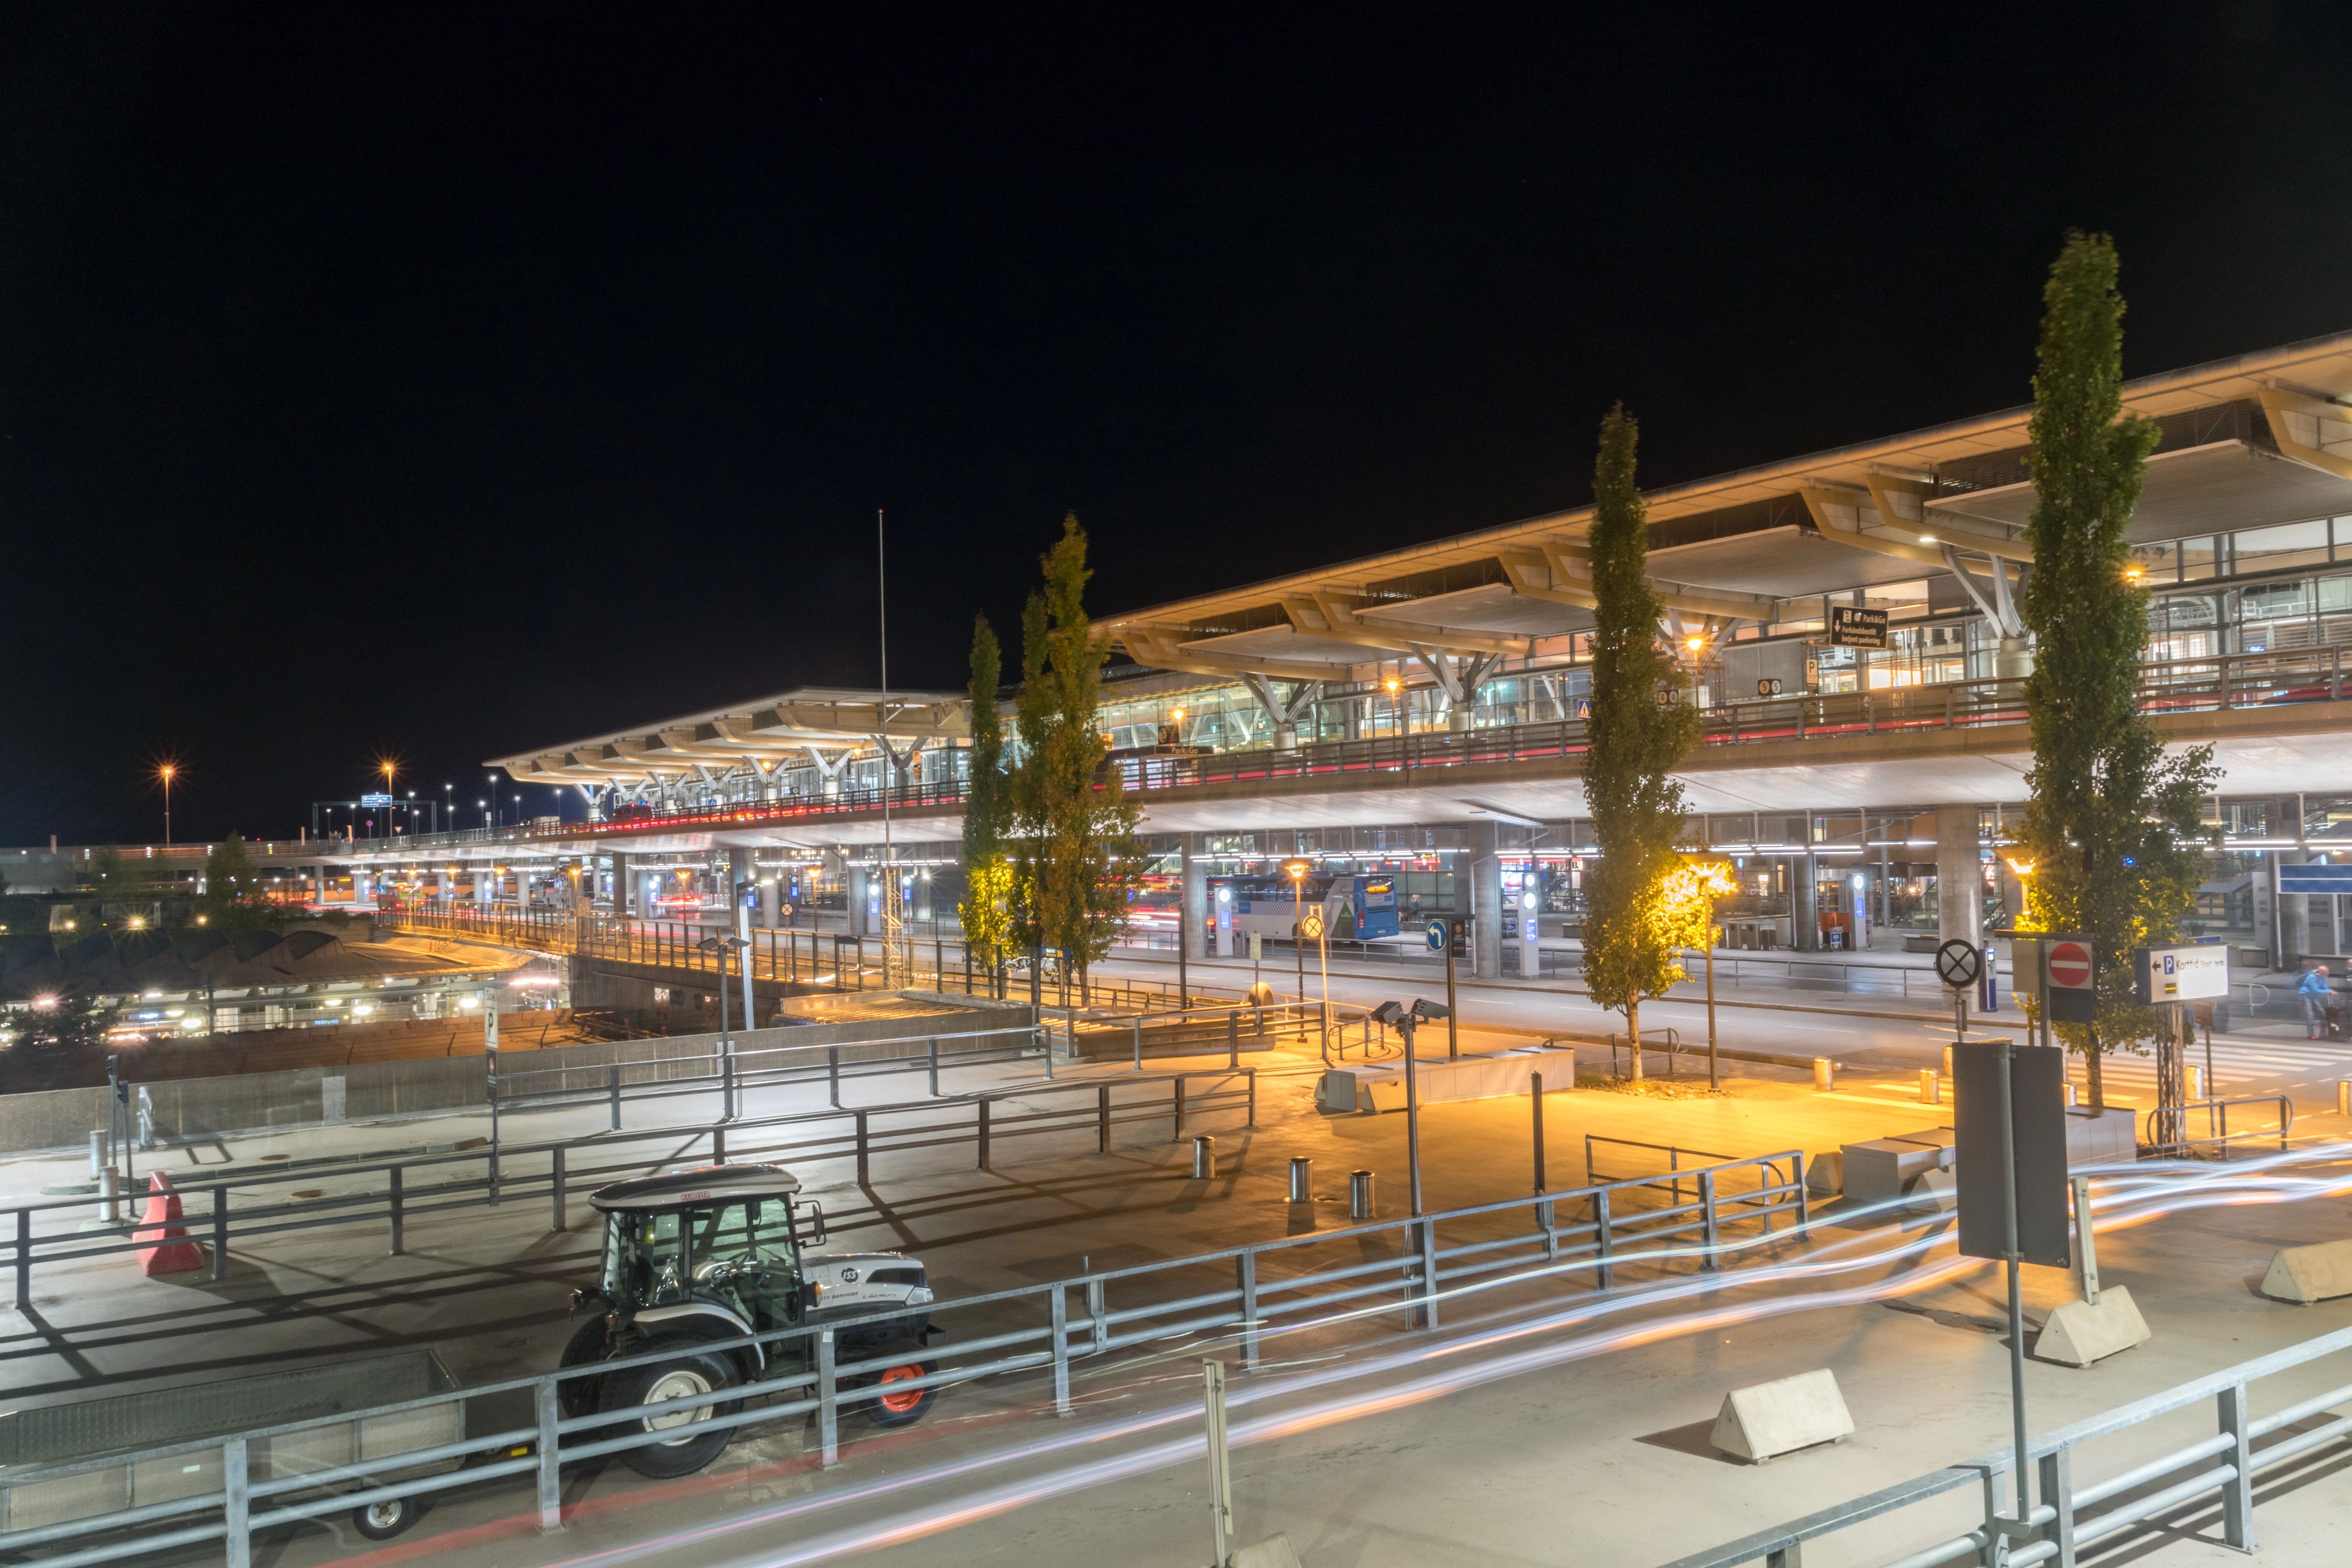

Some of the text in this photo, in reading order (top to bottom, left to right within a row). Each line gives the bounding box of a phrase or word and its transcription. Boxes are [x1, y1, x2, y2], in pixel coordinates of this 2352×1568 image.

[1863, 615, 1886, 624] Park&Go
[1809, 662, 1815, 673] P
[2166, 957, 2172, 973] P
[2176, 958, 2199, 970] Korttid
[488, 1012, 493, 1037] P
[681, 1191, 711, 1201] KUBOTA
